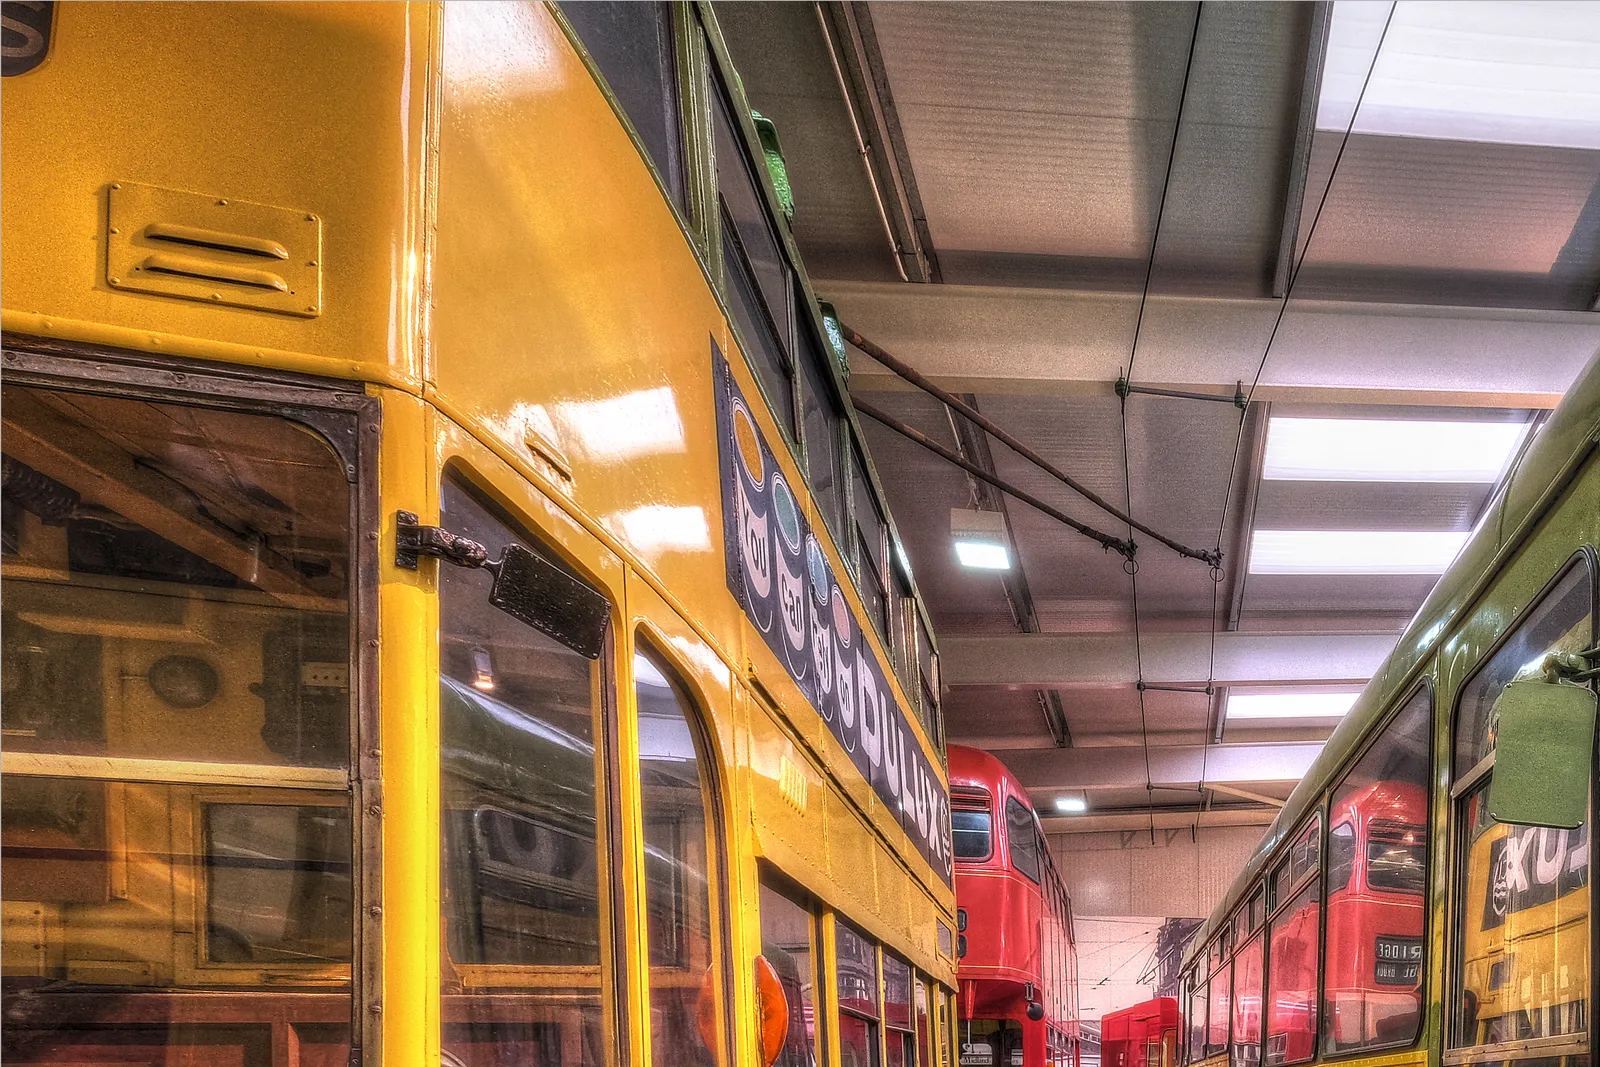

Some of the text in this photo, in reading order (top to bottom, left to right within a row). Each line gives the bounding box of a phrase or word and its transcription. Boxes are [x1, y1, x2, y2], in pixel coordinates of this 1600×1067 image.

[742, 491, 768, 578] You
[781, 573, 802, 633] can
[840, 673, 850, 712] on
[856, 647, 941, 861] DULUX
